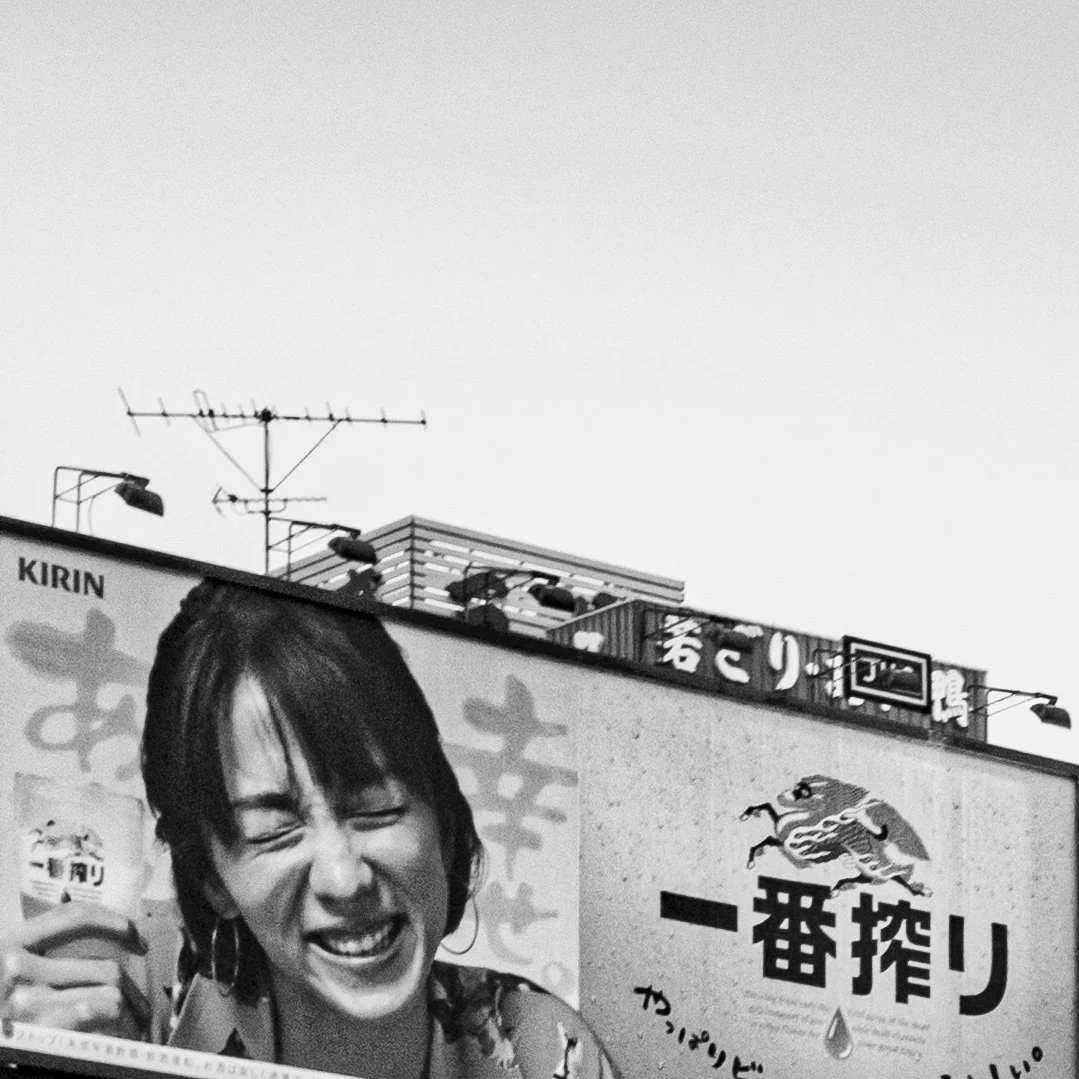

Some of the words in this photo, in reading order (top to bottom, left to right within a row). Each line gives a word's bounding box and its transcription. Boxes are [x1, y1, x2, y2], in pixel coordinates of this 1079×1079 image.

[17, 557, 105, 599] KIRIN
[659, 875, 1008, 1017] 一番搾り
